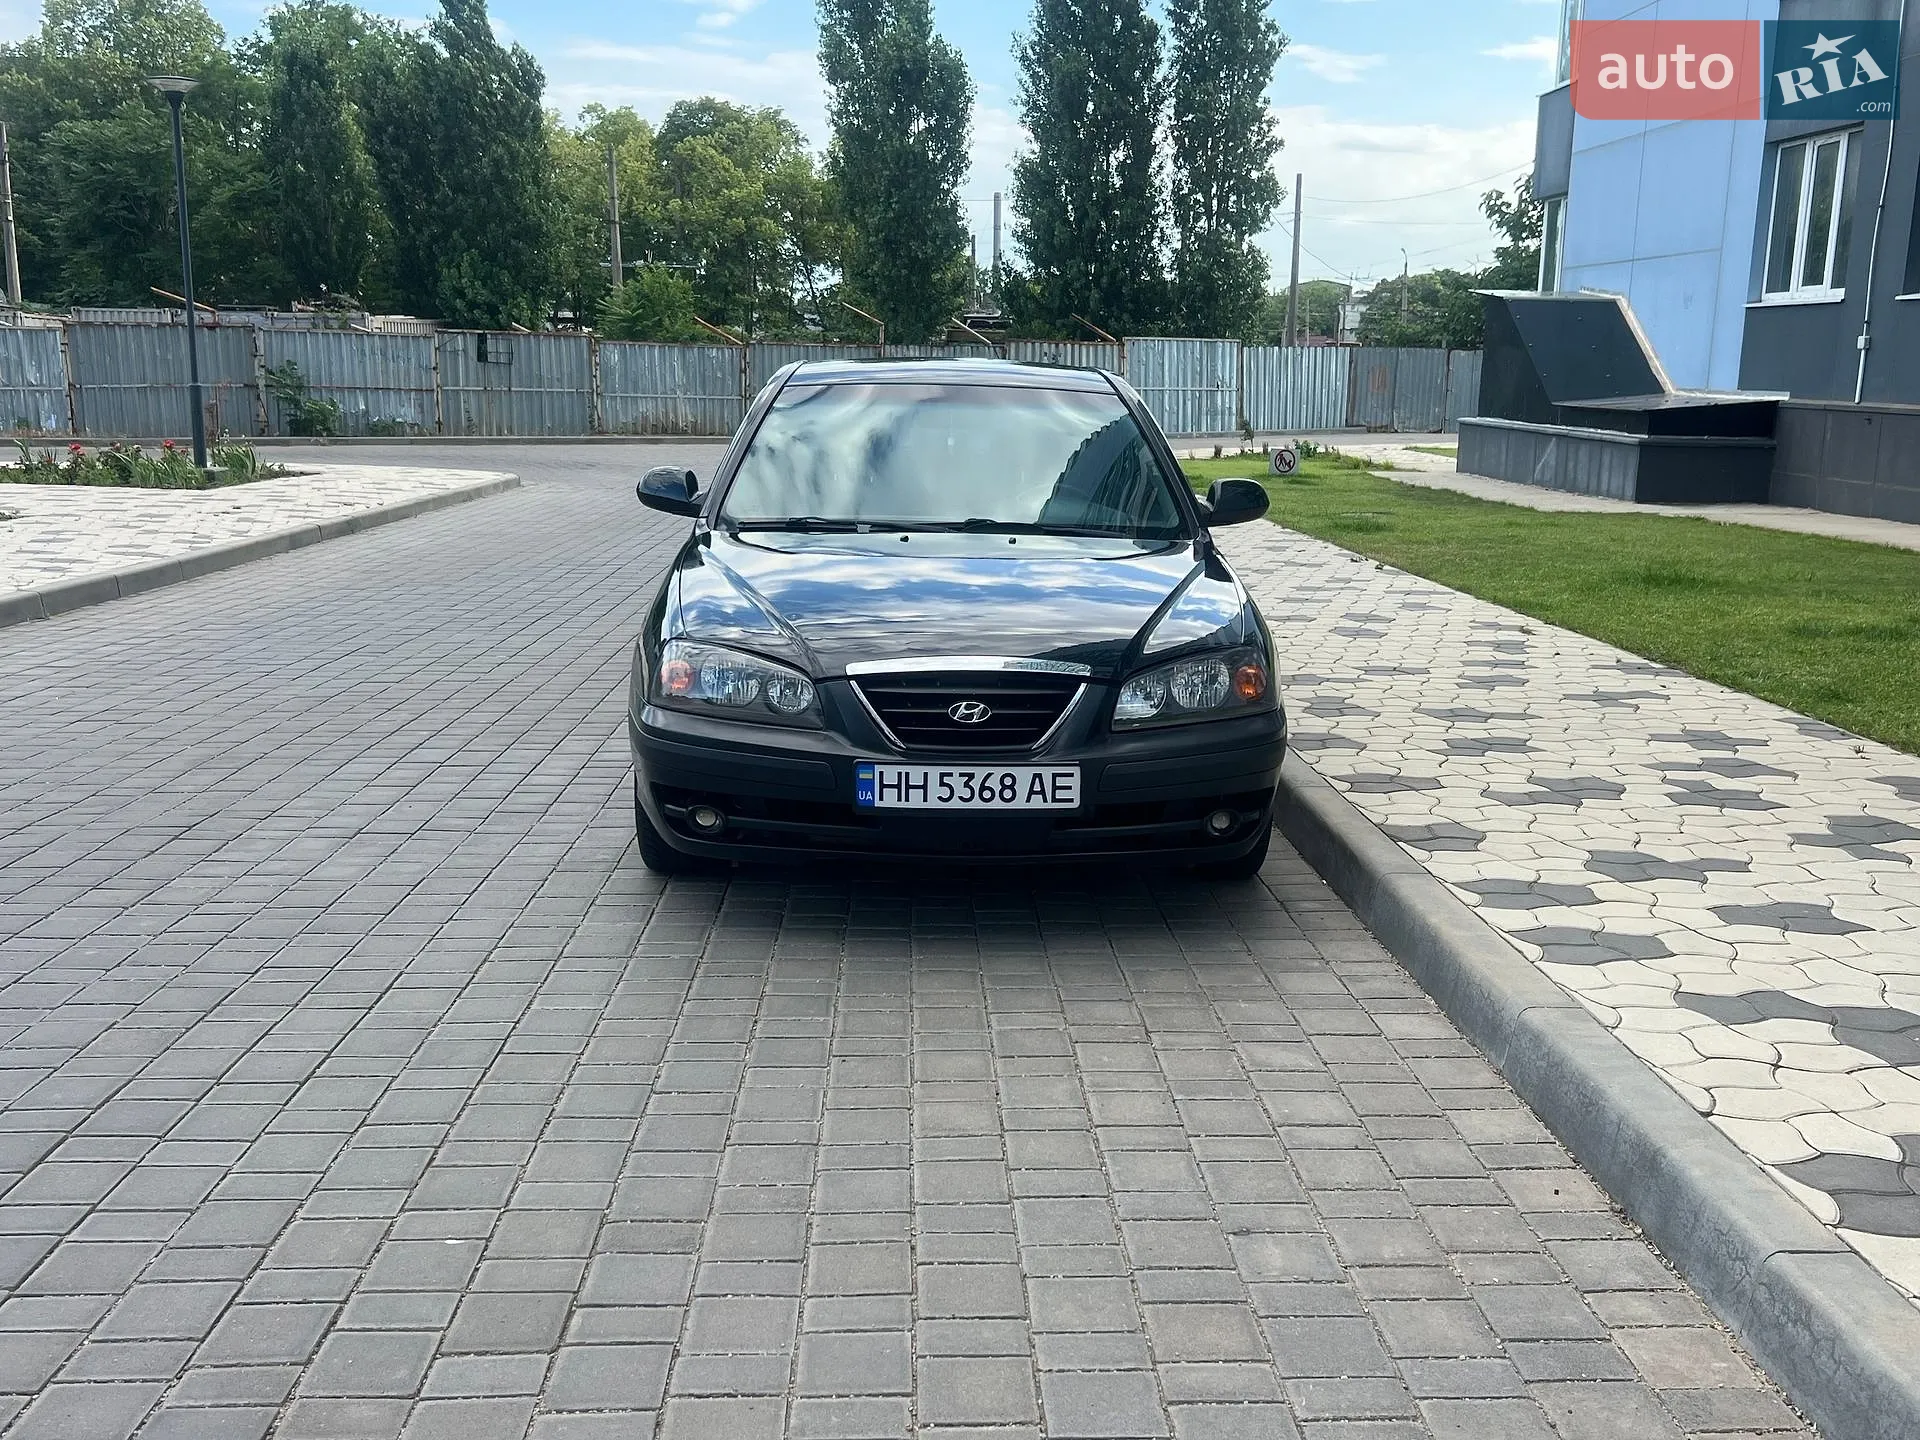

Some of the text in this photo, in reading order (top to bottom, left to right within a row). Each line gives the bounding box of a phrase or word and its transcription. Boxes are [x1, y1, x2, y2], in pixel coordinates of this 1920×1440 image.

[858, 790, 873, 801] UA
[878, 770, 1075, 804] HH 5368 AE
